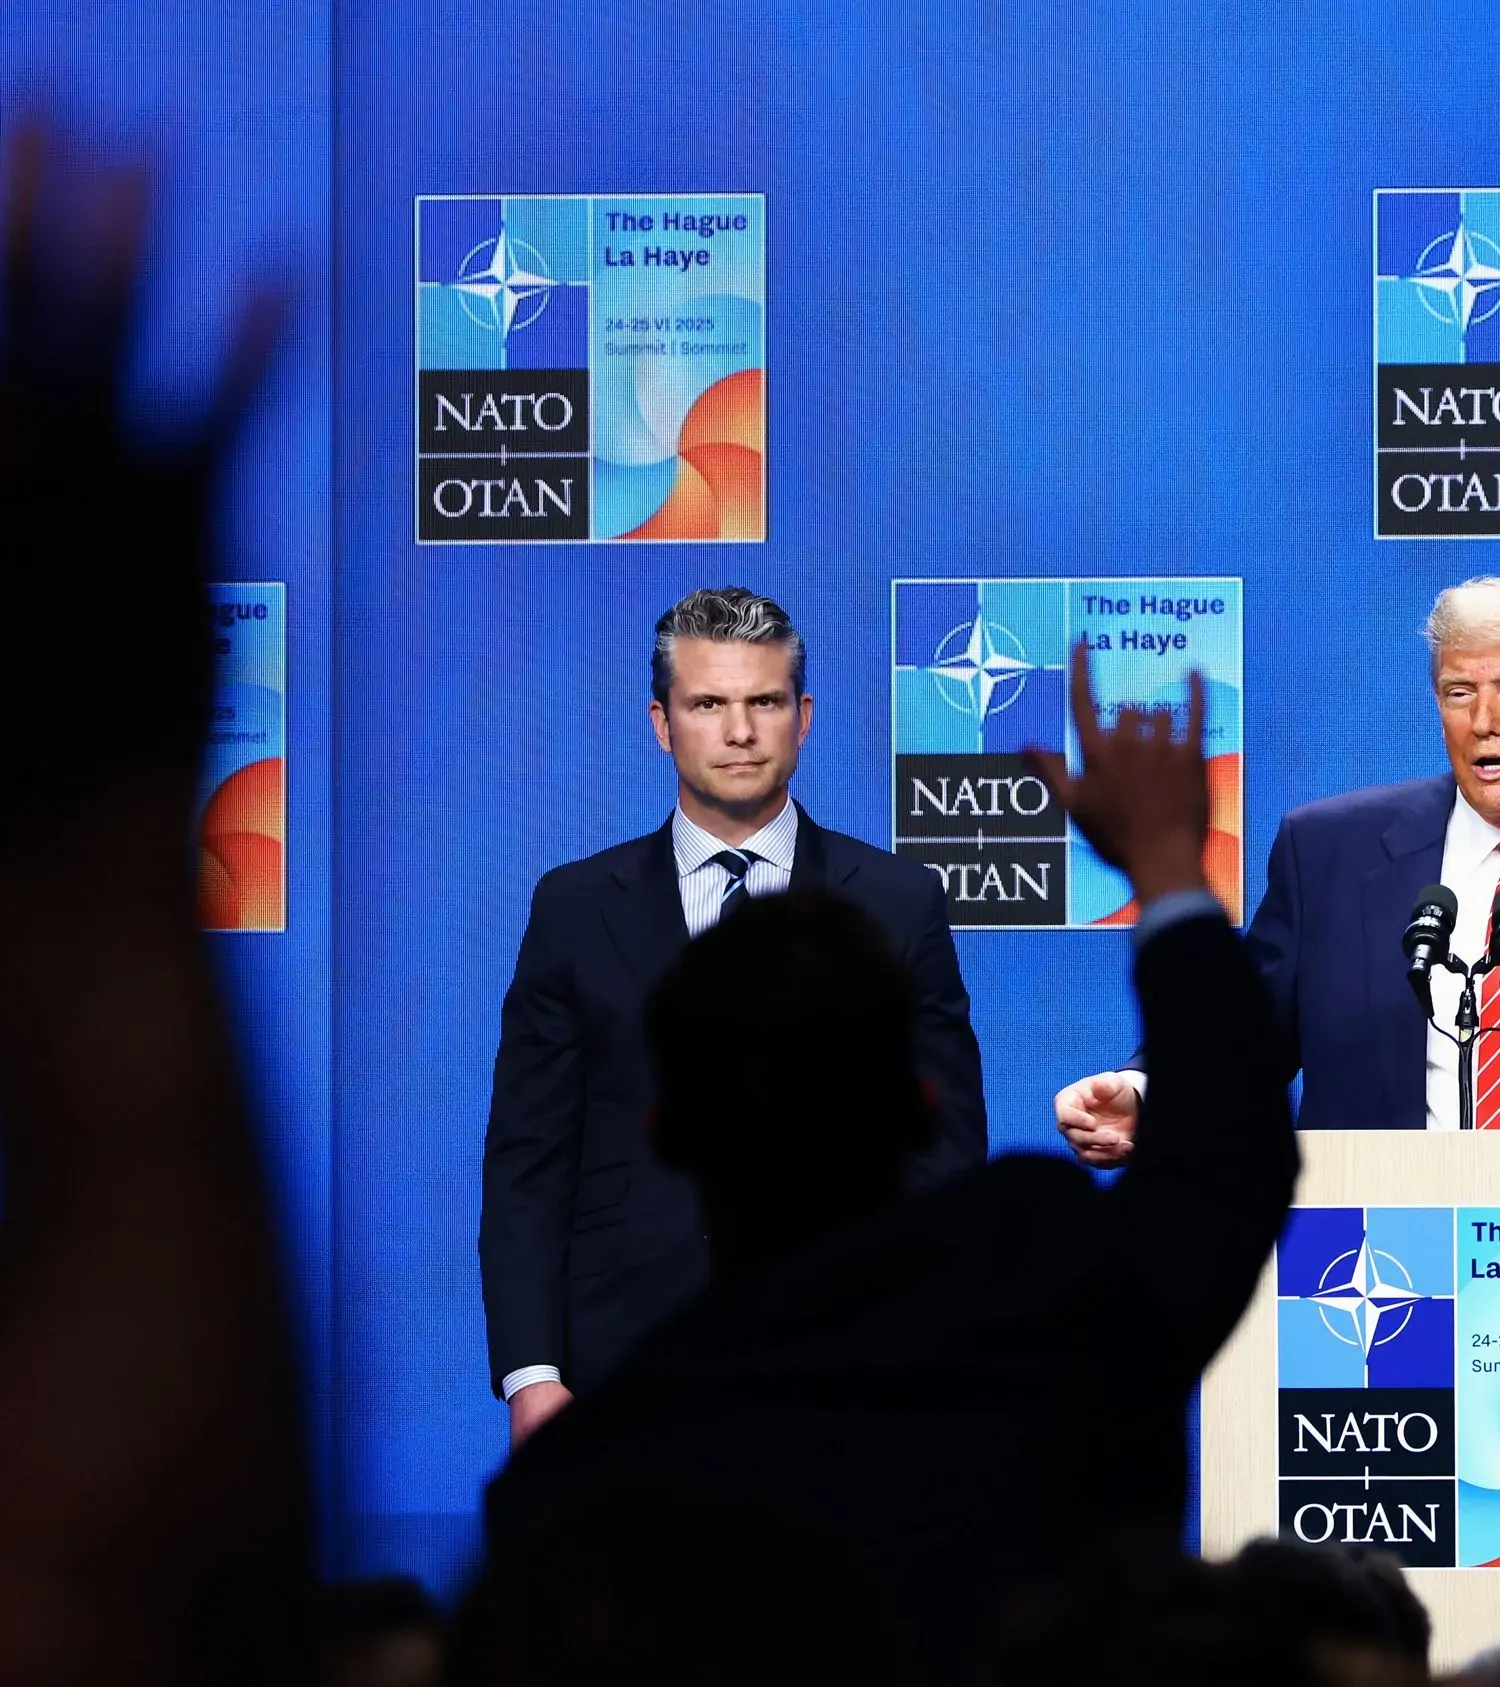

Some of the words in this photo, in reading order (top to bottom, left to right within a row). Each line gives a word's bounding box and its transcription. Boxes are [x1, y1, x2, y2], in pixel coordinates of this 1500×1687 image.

[605, 212, 654, 231] The
[663, 212, 747, 237] Hague
[605, 247, 636, 267] La
[643, 247, 710, 272] Haye
[605, 318, 649, 331] 24-25
[655, 318, 671, 331] VI
[675, 318, 714, 331] 2025
[605, 342, 666, 355] Summit
[680, 342, 747, 355] Sommet
[434, 392, 573, 431] NATO
[433, 479, 573, 518] OTAN
[217, 603, 267, 627] gue
[1083, 595, 1131, 615] The
[1140, 596, 1225, 622] Hague
[1121, 630, 1187, 656] Haye
[911, 776, 1050, 816] NATO
[1293, 1411, 1438, 1453] NATO
[1293, 1502, 1440, 1544] OTAN
